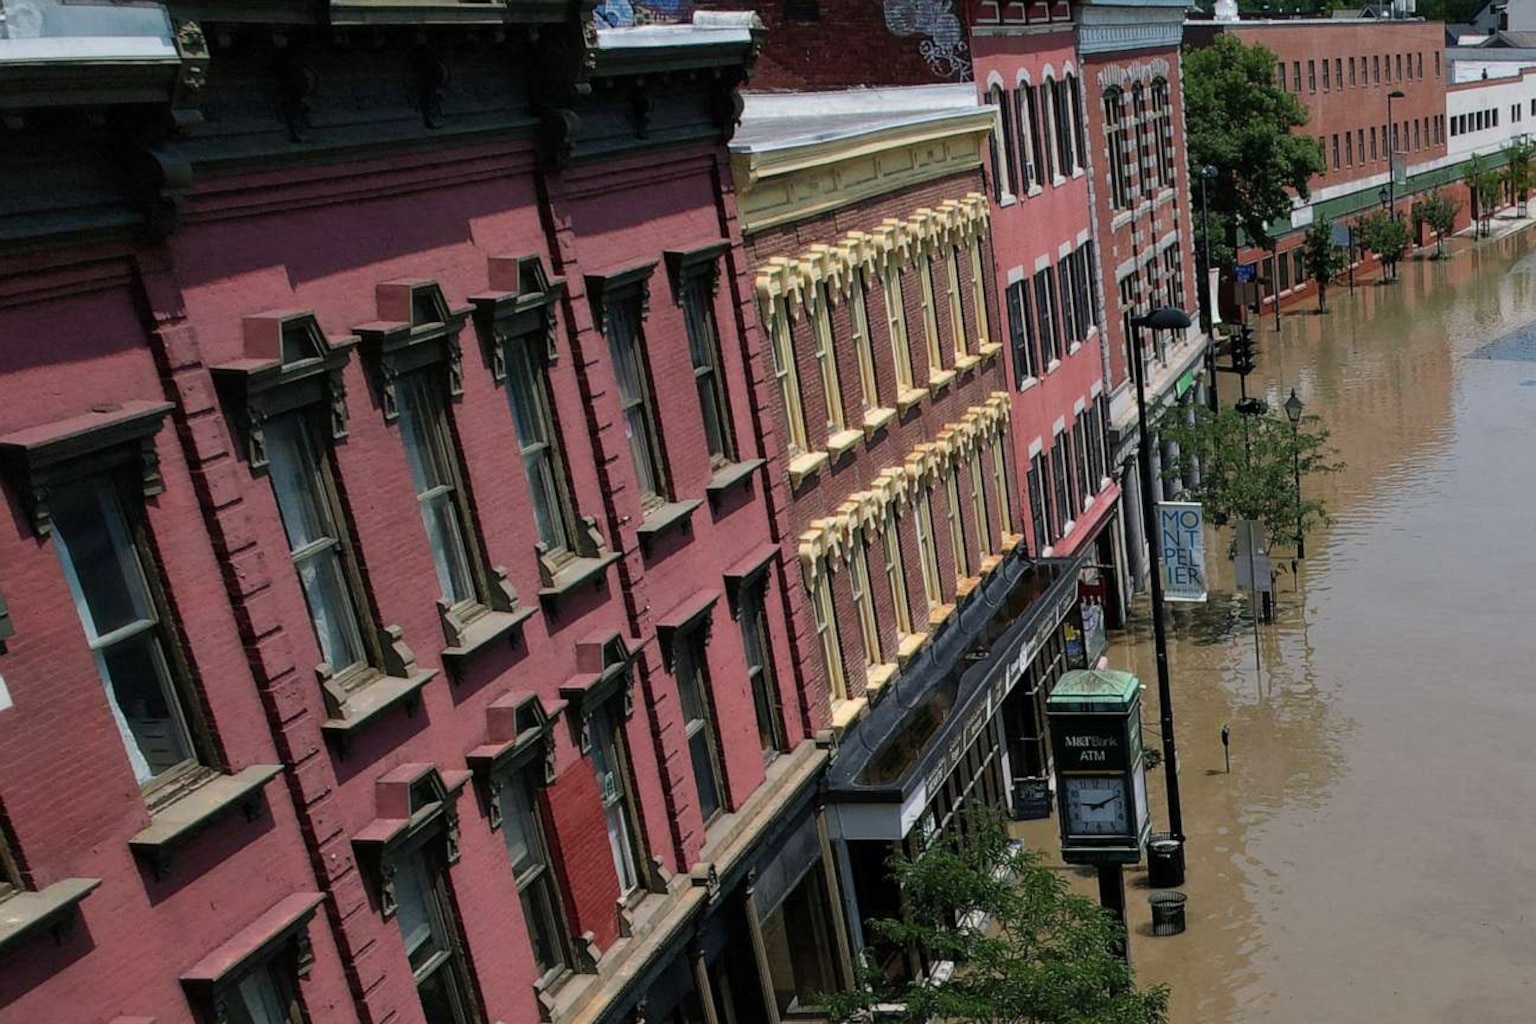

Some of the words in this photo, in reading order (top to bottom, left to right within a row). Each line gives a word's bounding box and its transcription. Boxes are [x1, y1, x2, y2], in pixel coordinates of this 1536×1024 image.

[1162, 510, 1199, 529] MO
[1164, 530, 1199, 548] NT
[1165, 548, 1200, 566] PEL
[1168, 567, 1202, 585] IER
[1080, 751, 1106, 761] ATM
